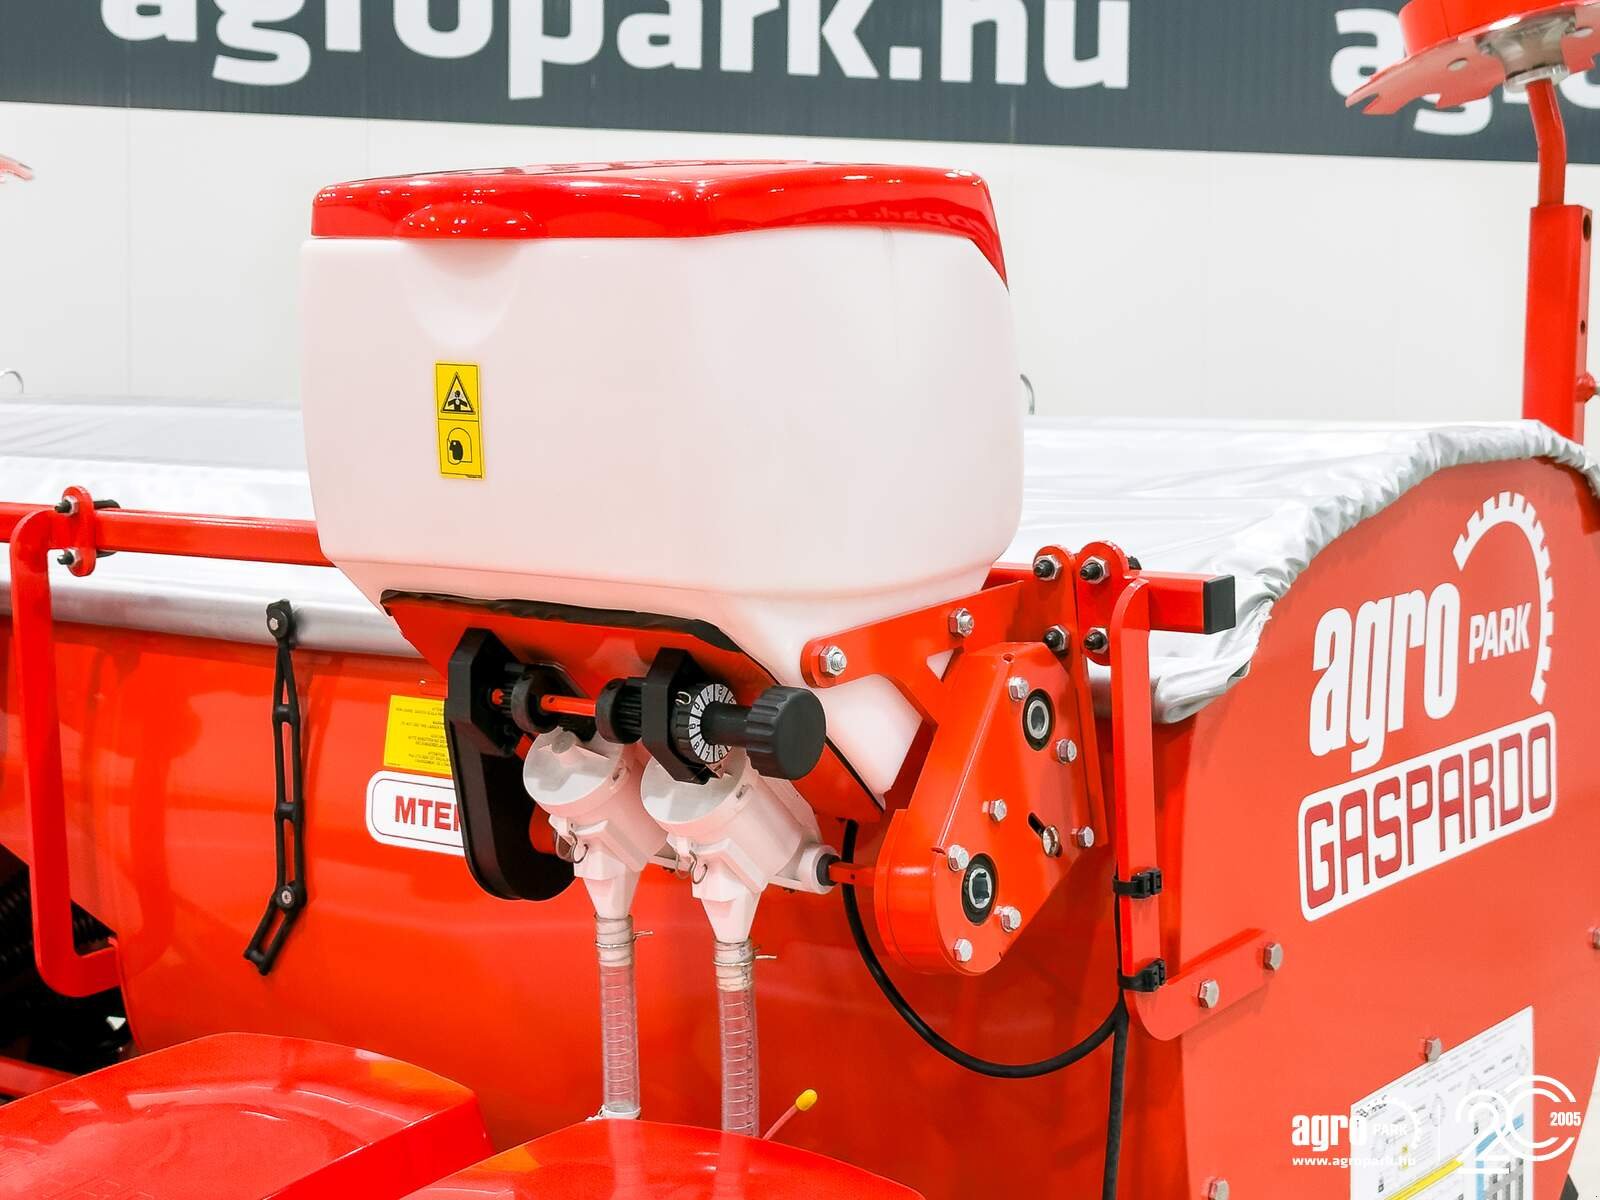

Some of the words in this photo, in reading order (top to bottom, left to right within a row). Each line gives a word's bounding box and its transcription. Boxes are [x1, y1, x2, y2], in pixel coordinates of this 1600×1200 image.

[1308, 581, 1460, 773] agro
[1468, 602, 1532, 665] PARK
[1304, 722, 1552, 910] GASPARDO
